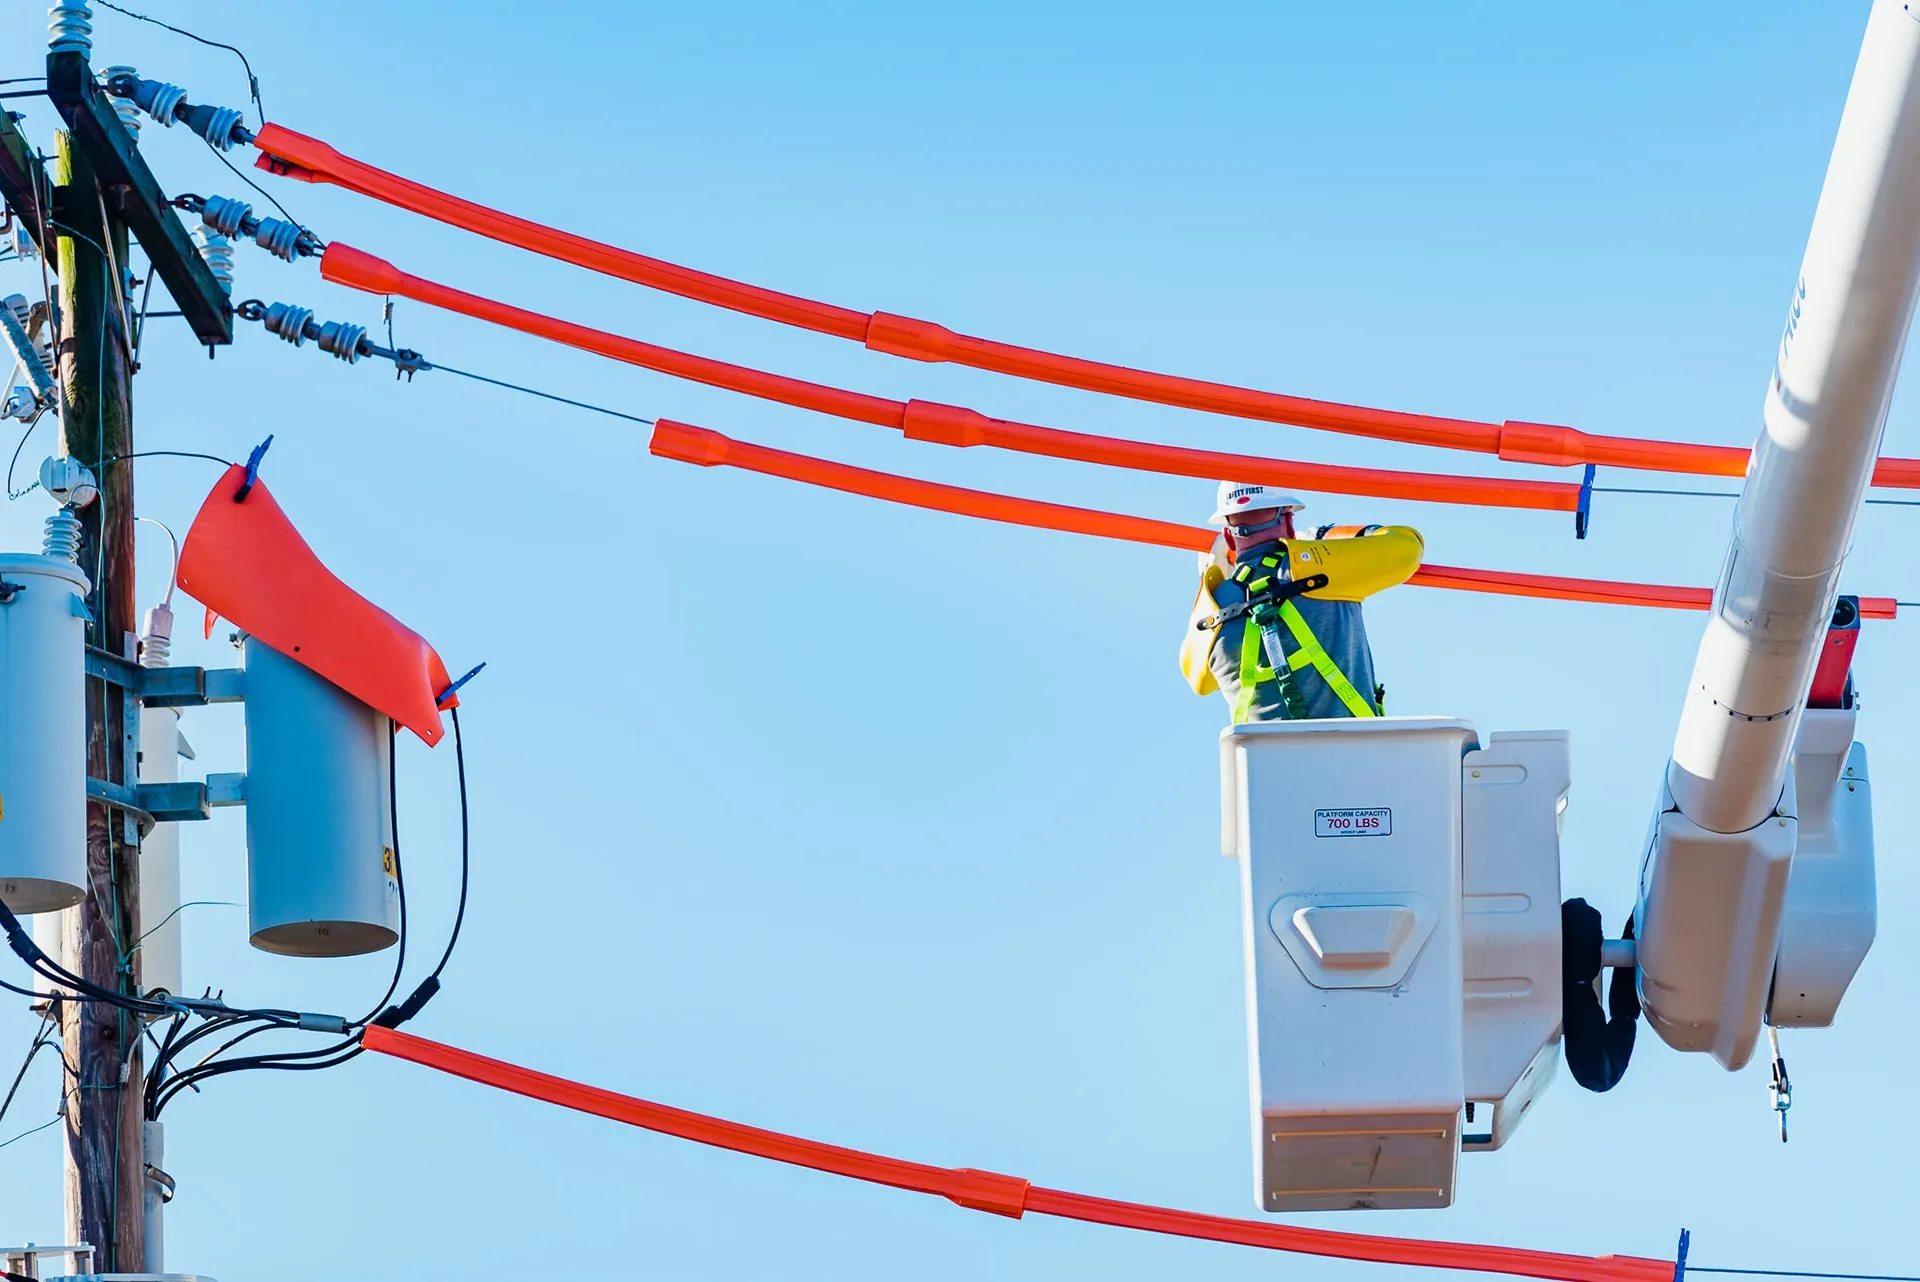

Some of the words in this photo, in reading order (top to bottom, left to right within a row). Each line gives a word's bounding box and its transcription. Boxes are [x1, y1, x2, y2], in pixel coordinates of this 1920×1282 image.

[1246, 487, 1263, 495] FIRST
[1327, 818, 1351, 829] 700
[1355, 818, 1379, 828] LBS
